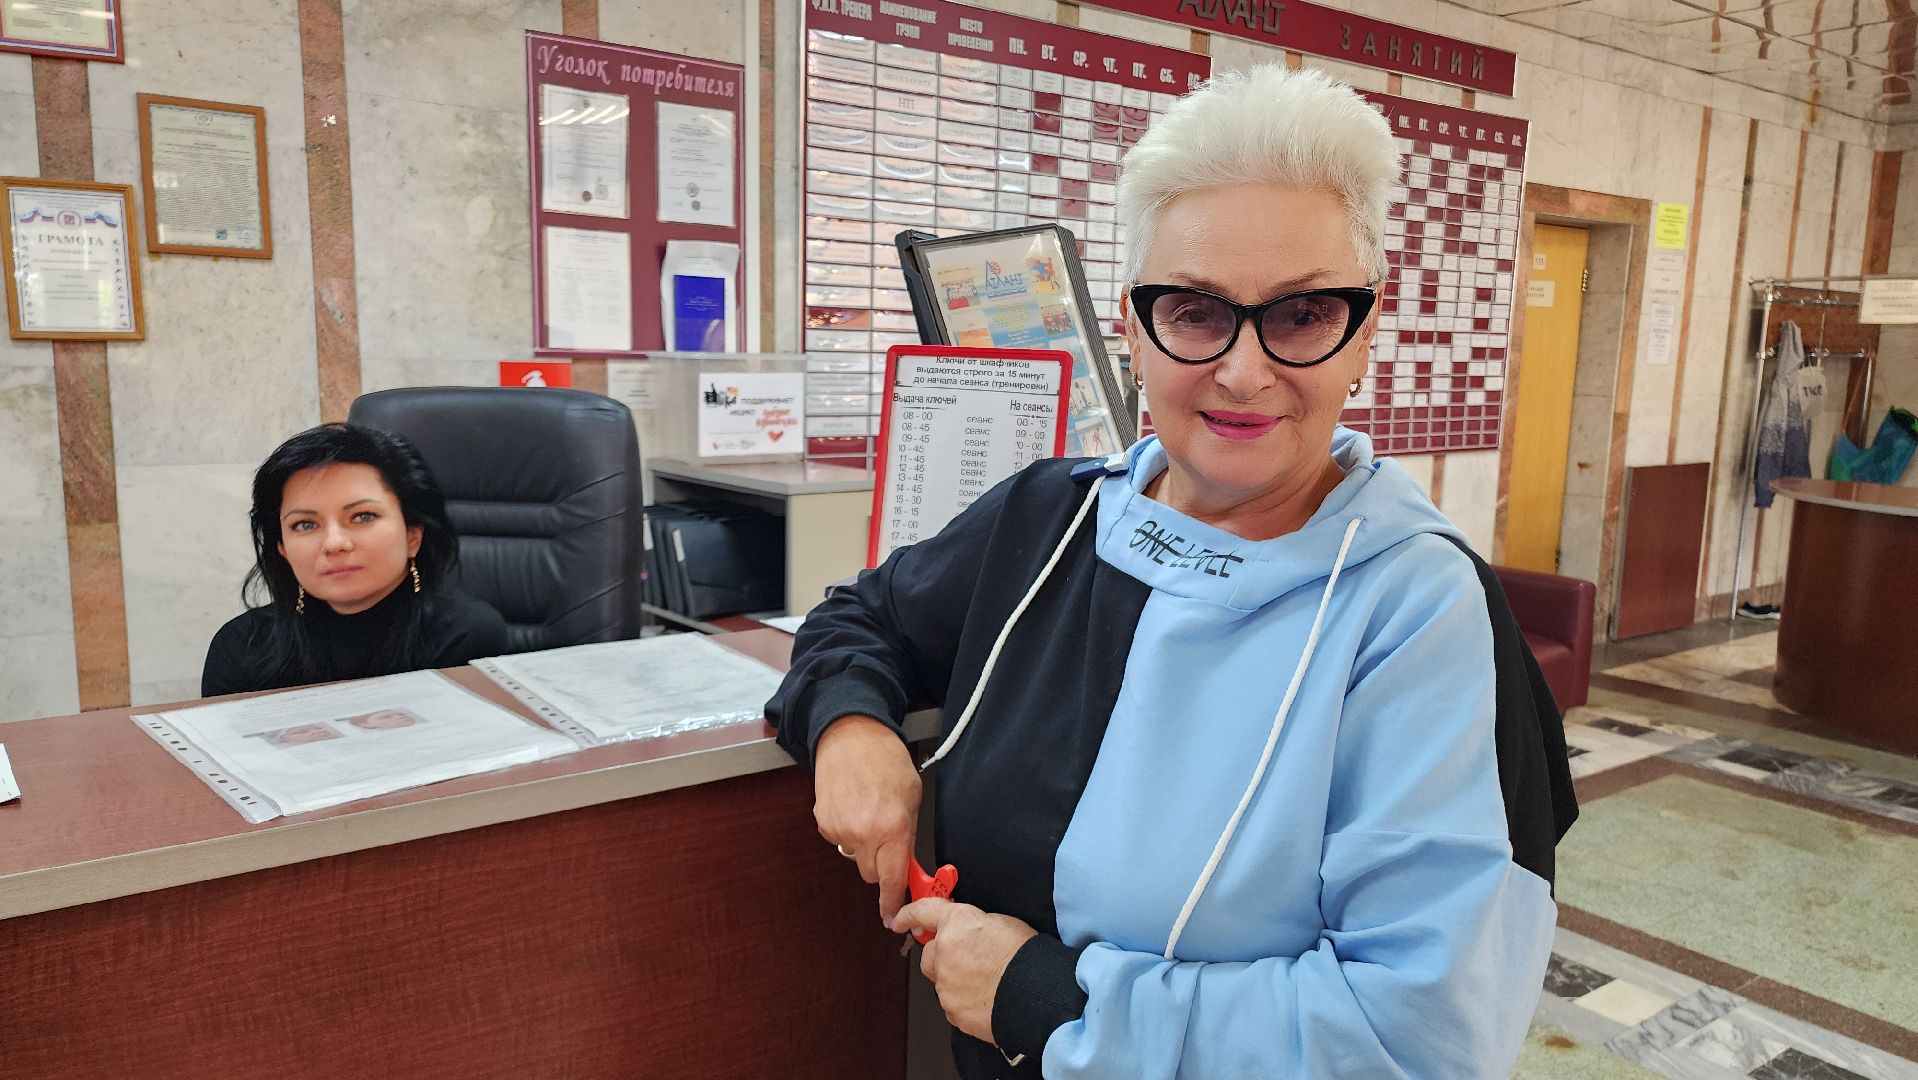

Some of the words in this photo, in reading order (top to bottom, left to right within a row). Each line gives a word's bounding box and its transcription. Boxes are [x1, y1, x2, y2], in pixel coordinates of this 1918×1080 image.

[959, 17, 984, 34] МЕСТО
[947, 32, 994, 53] ПРОВЕДЕНИЯ
[1340, 23, 1486, 81] ЗАНЯТИЙ
[1008, 37, 1028, 56] ПН.
[1041, 44, 1058, 61] ВТ.
[1073, 50, 1089, 68] СР.
[1102, 56, 1119, 74] ЧТ.
[1132, 62, 1148, 79] ПТ.
[1159, 67, 1176, 84] СБ.
[537, 45, 611, 86] Уголок
[620, 63, 735, 98] потребителя
[37, 233, 105, 247] ГРАМОТА
[936, 356, 965, 366] Ключи
[967, 358, 977, 366] от
[979, 358, 1030, 370] шкафчиков
[916, 366, 961, 377] выдаются
[963, 368, 993, 379] строго
[994, 370, 1005, 378] за
[1007, 370, 1017, 379] 15
[1018, 372, 1046, 382] минут
[912, 376, 925, 385] до
[926, 377, 958, 386] начала
[959, 378, 989, 388] сеанса
[991, 379, 1050, 391] (тренировки)
[893, 391, 924, 405] Выдача
[925, 395, 957, 407] ключей
[1009, 399, 1021, 412] На
[1022, 401, 1054, 414] сеансы
